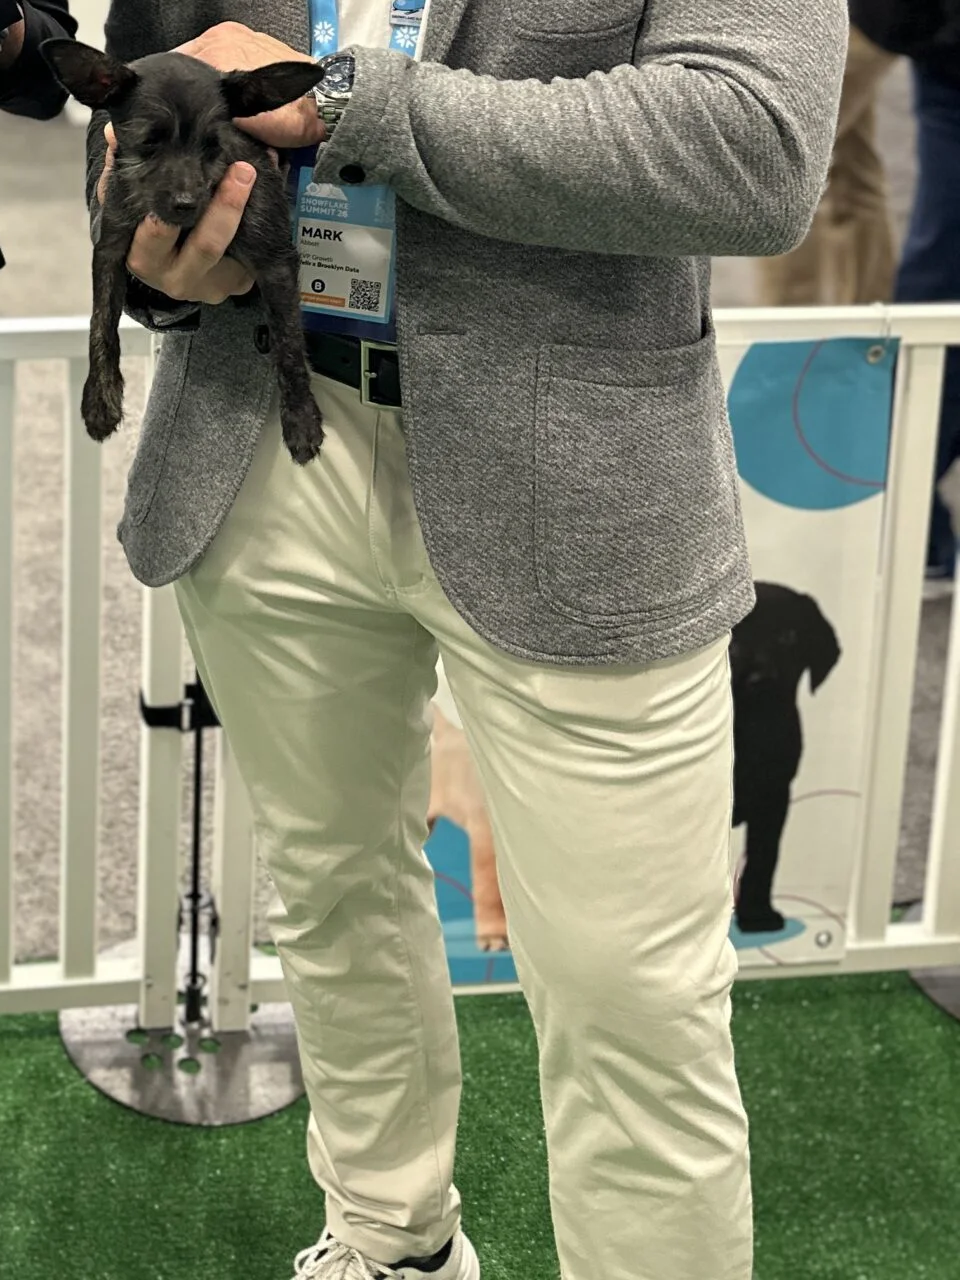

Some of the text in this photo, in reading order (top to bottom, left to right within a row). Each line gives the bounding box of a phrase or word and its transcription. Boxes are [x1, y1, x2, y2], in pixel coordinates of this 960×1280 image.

[301, 197, 348, 209] SNOWFLAKE
[301, 204, 336, 215] SUMMIT
[301, 226, 343, 242] MARK
[317, 262, 344, 271] Brooklyn
